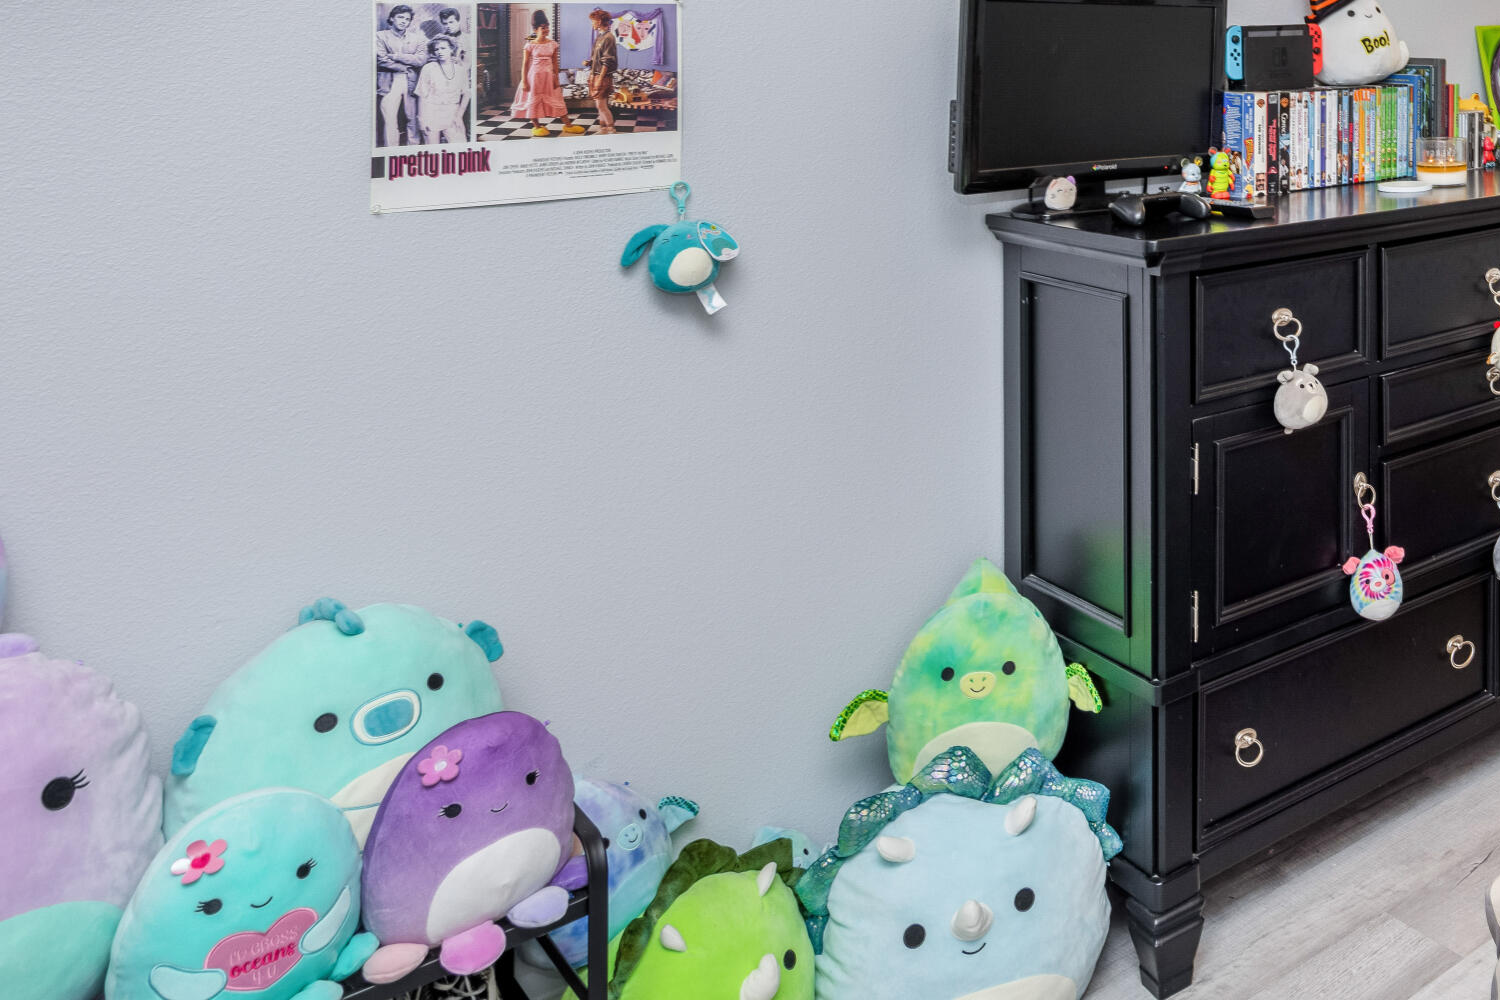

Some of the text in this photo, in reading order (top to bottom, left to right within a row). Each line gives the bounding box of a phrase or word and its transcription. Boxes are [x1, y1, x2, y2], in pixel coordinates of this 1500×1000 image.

[1360, 29, 1390, 54] Boo!
[388, 150, 440, 181] pretty
[441, 149, 456, 175] in
[458, 147, 491, 176] pink
[229, 941, 297, 979] oceans
